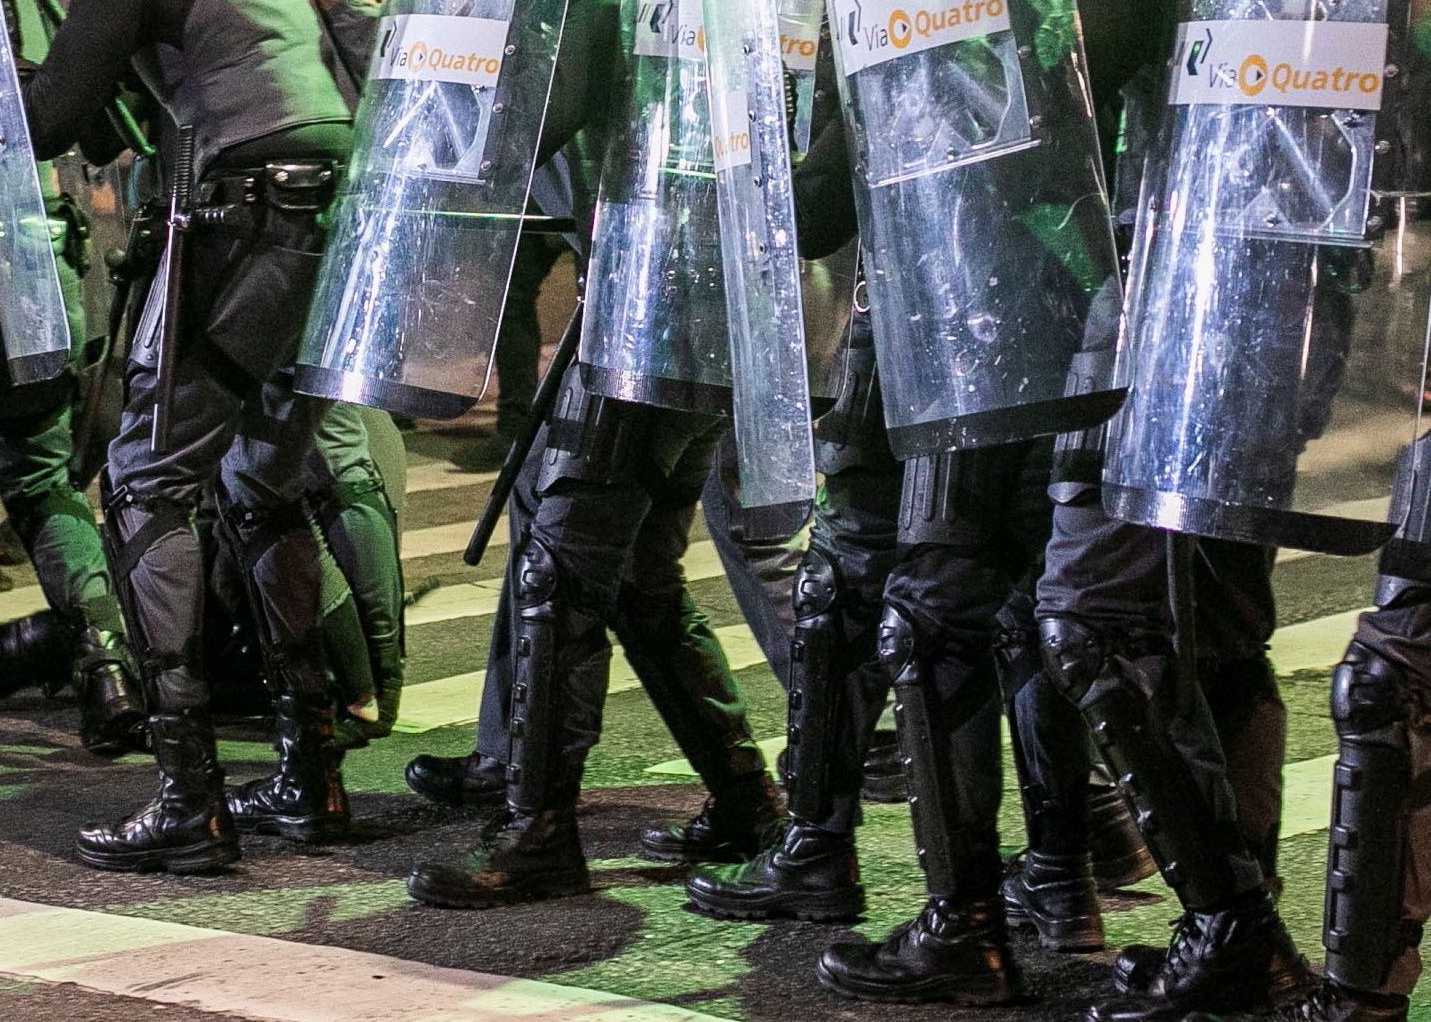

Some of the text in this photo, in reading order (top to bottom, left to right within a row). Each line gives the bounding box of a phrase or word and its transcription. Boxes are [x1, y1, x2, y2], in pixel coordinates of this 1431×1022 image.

[864, 24, 889, 51] Via
[390, 46, 500, 74] Via Quatro
[1272, 63, 1380, 93] Quatro
